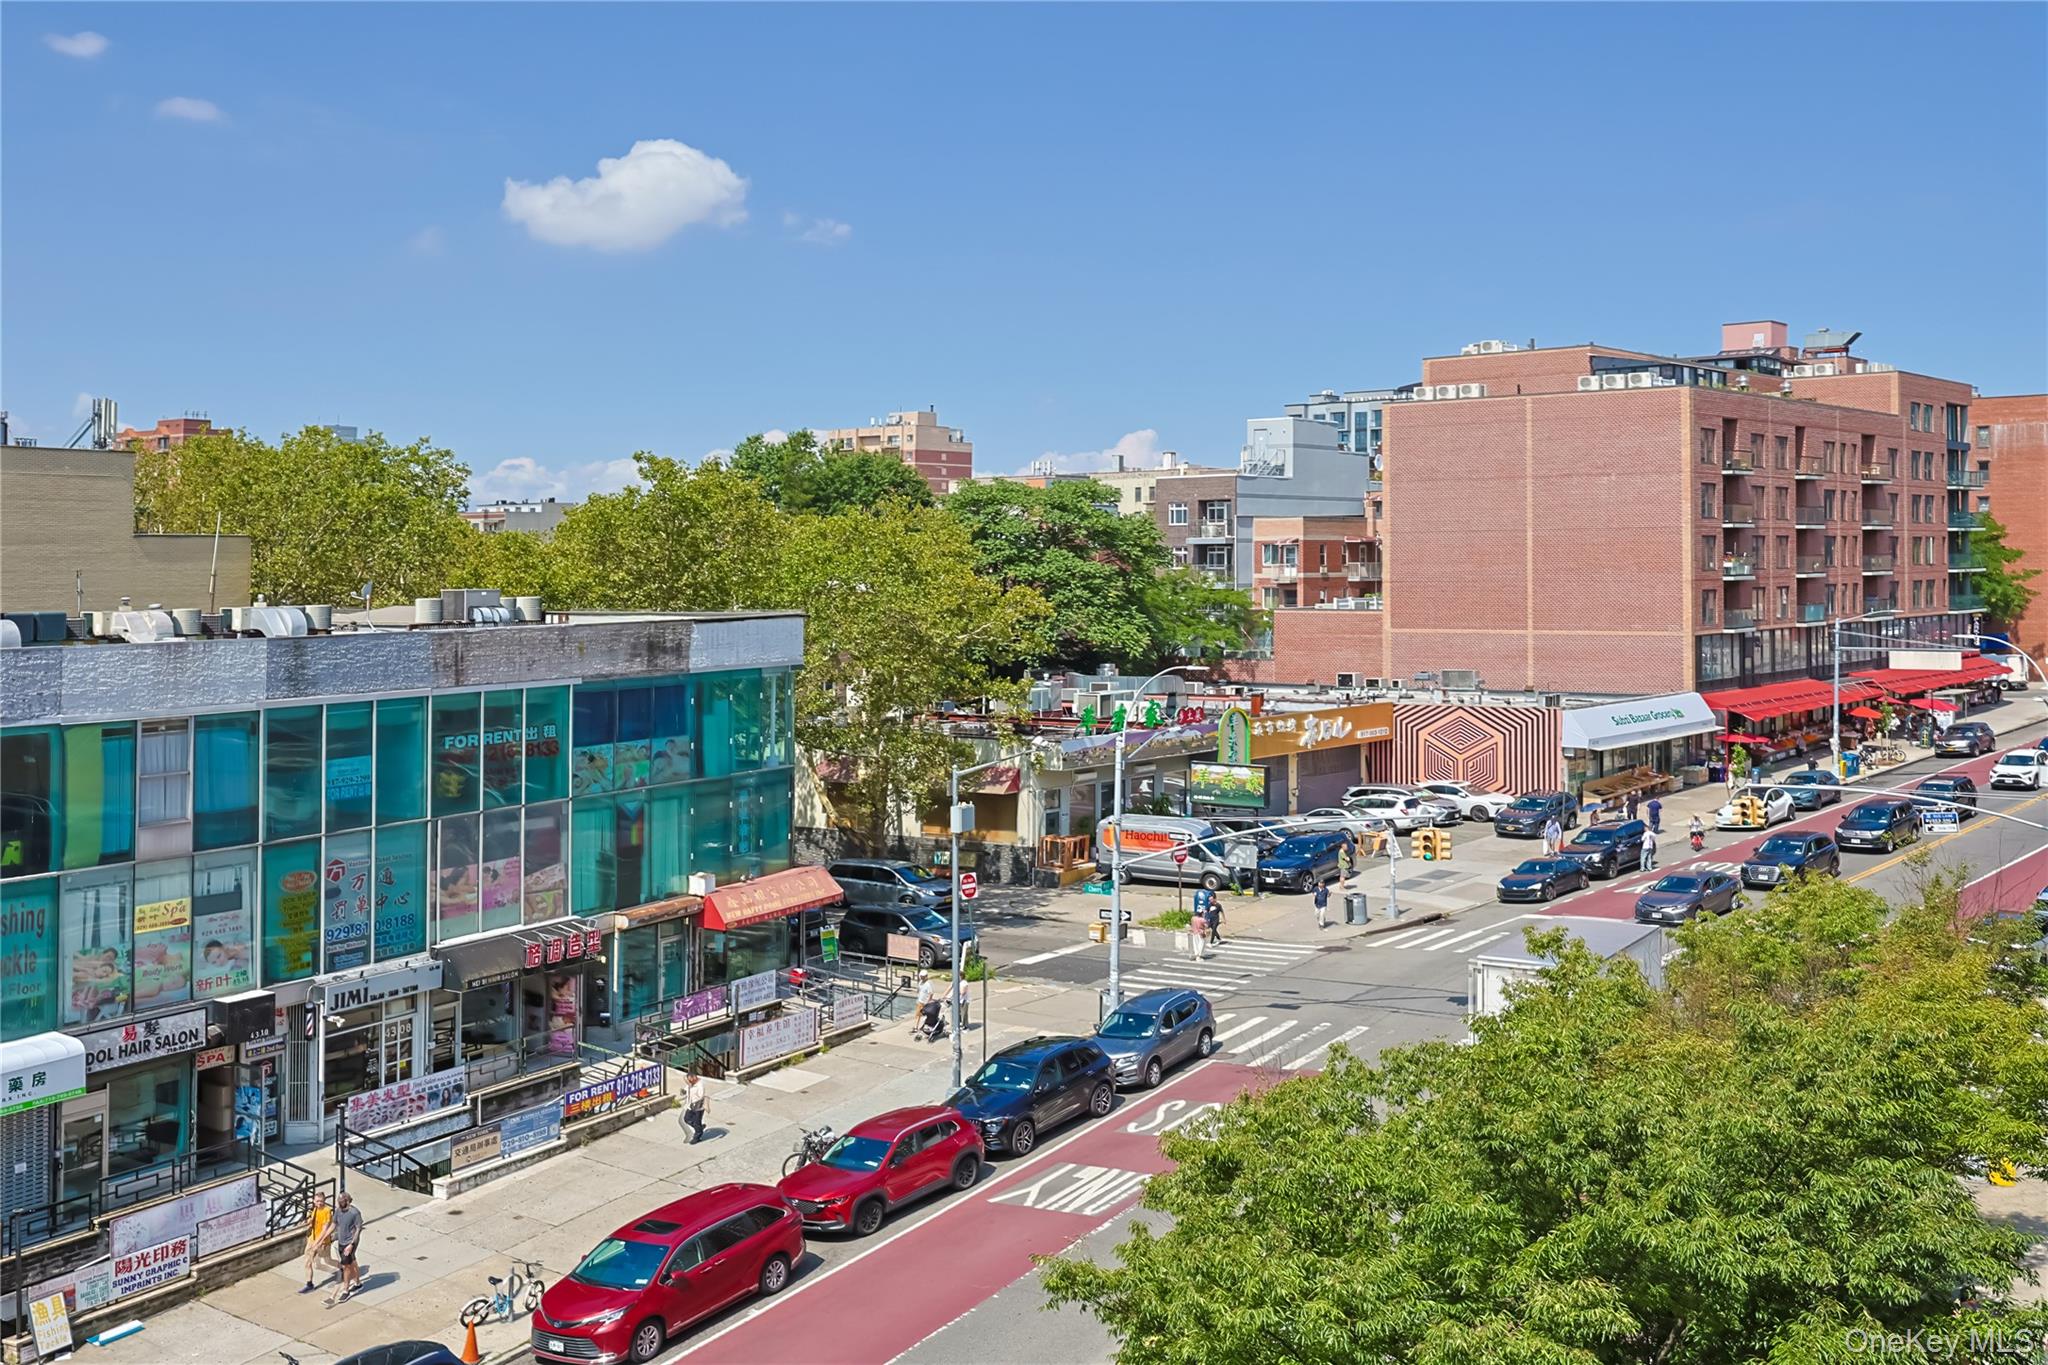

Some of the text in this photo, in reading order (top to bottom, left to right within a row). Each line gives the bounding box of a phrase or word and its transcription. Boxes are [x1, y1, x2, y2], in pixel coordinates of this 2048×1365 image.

[1629, 711, 1651, 724] Bazaar
[444, 724, 557, 750] FOR RENT 出租
[161, 903, 186, 918] Spa
[525, 929, 601, 969] 格调造型
[163, 963, 183, 973] Work
[330, 987, 369, 1011] JIMI
[118, 1039, 151, 1059] HAIR
[155, 1028, 199, 1051] SALON
[250, 1028, 269, 1039] 4310
[197, 1052, 225, 1068] SPA
[8, 1071, 47, 1094] 藥房
[569, 1066, 660, 1104] FOR RENT 917-216-8133
[114, 1238, 188, 1277] 陽光印務
[112, 1270, 144, 1288] SUNNY
[145, 1260, 181, 1277] GRAPHIC
[121, 1273, 162, 1295] IMPRINTS
[163, 1268, 180, 1282] INC.
